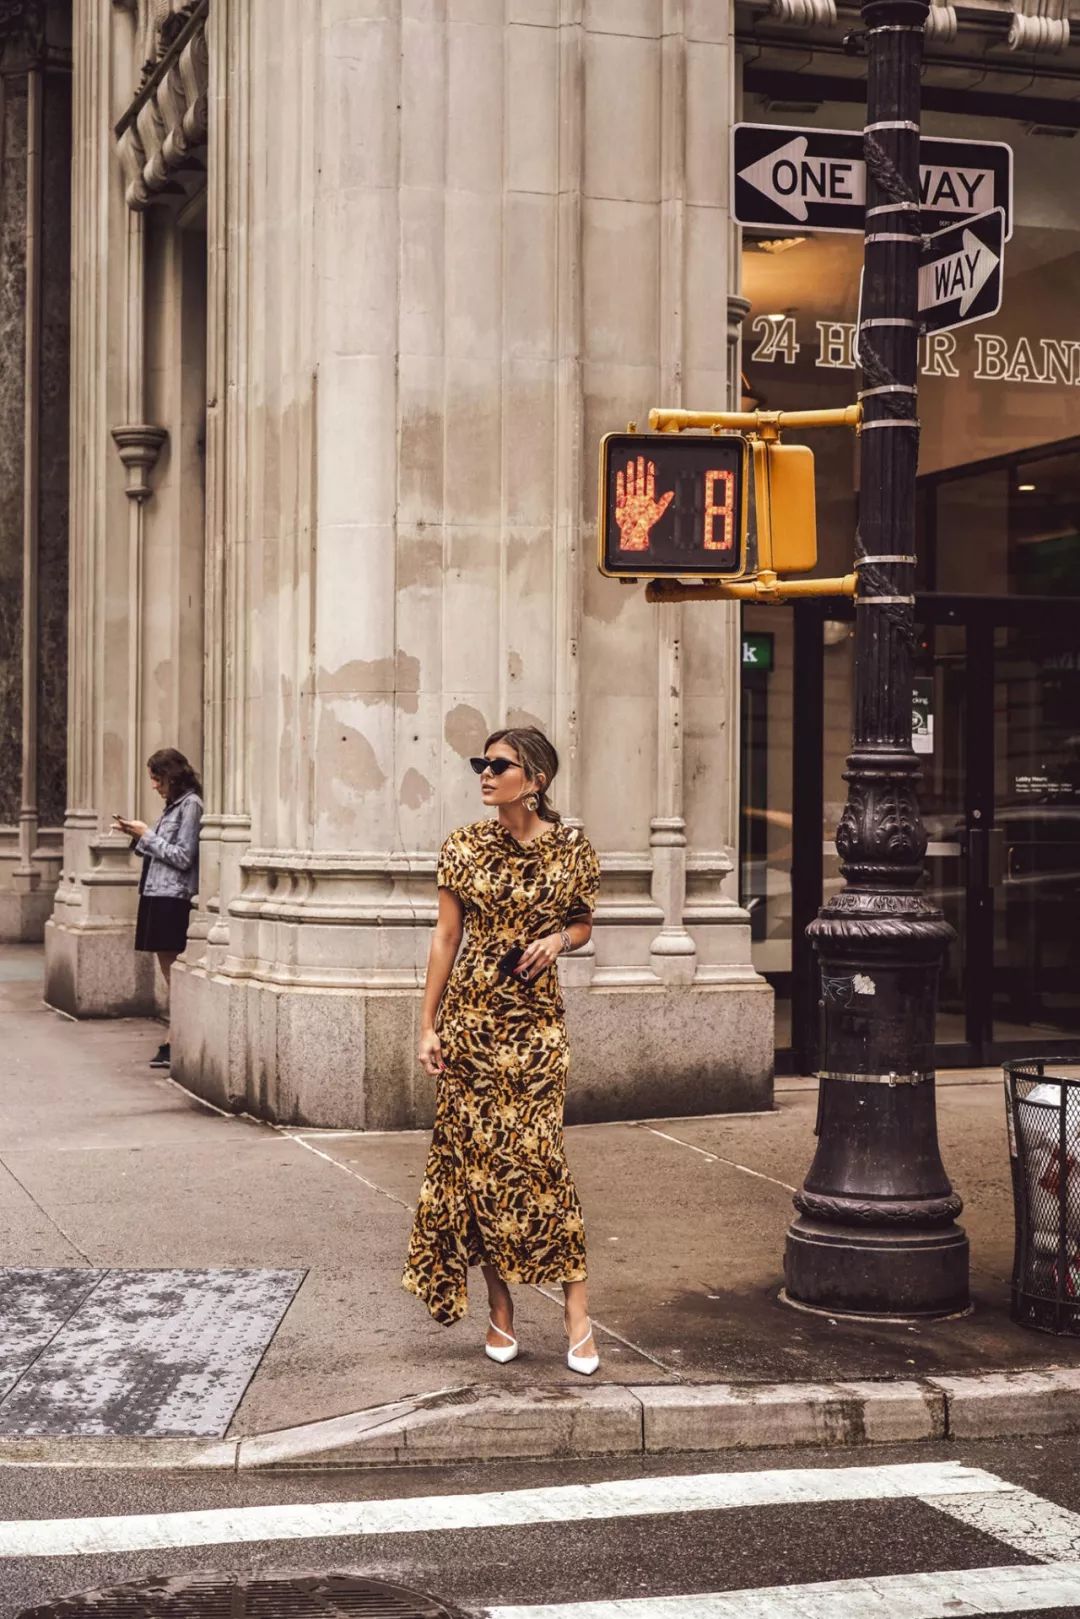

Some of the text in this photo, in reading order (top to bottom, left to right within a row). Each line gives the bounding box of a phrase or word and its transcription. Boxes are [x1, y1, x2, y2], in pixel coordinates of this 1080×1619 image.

[772, 159, 852, 199] ONE
[935, 249, 981, 300] WAY
[751, 315, 1080, 386] 24 HR BAN
[704, 470, 734, 550] 8
